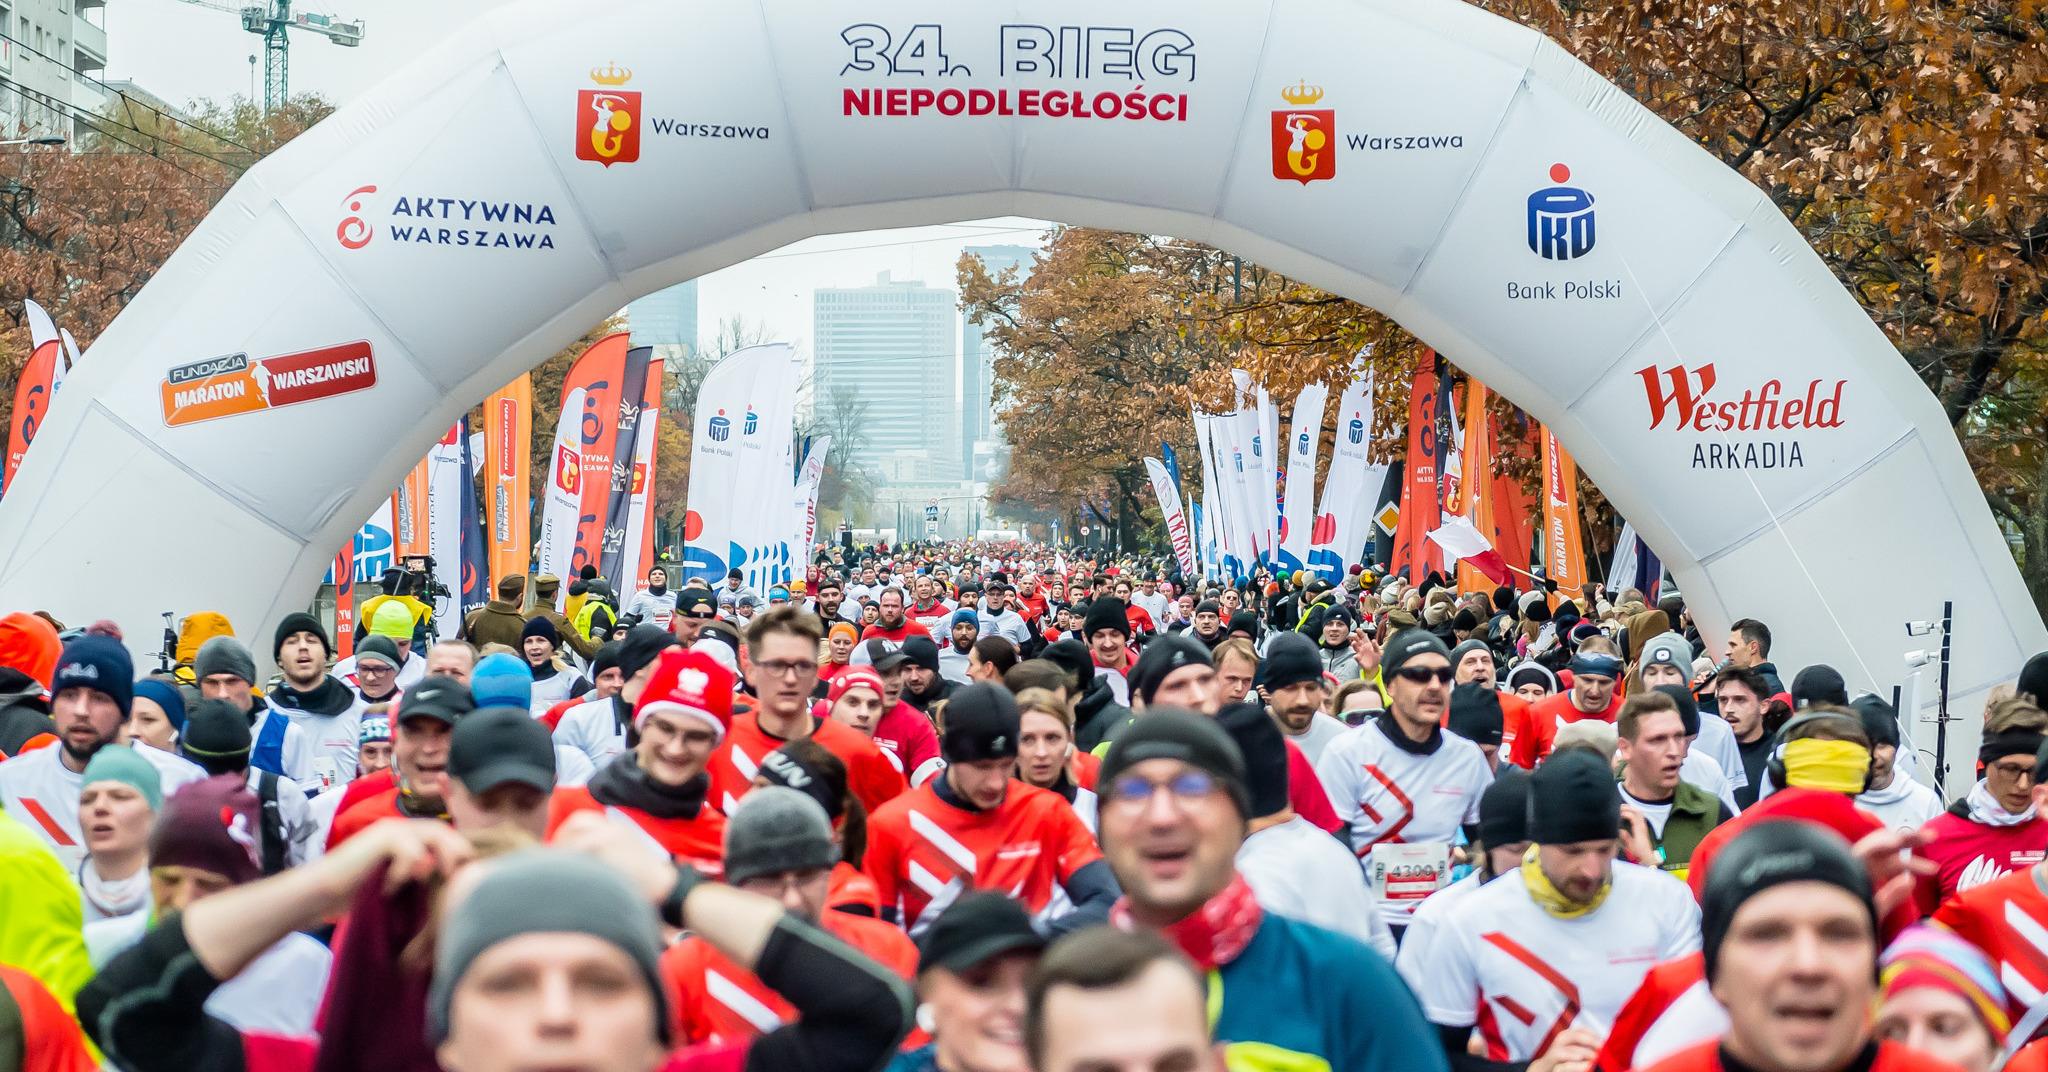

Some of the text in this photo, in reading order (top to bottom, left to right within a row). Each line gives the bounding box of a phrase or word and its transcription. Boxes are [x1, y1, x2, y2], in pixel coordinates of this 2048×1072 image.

[840, 24, 1196, 82] 34. BIEG
[842, 84, 1189, 121] NIEPODLEGŁOŚCI
[651, 116, 770, 140] Warszawa
[1346, 132, 1463, 151] Warszawa
[392, 196, 556, 226] AKTYWNA
[390, 225, 556, 250] WARSZAWA
[1507, 279, 1622, 300] Bank Polski
[172, 356, 246, 382] FUNDACJA
[174, 356, 370, 409] MARATON WARSZAWSKI
[1633, 362, 1848, 433] Westfield
[1691, 440, 1804, 470] ARKADIA
[1554, 517, 1568, 579] MARATON
